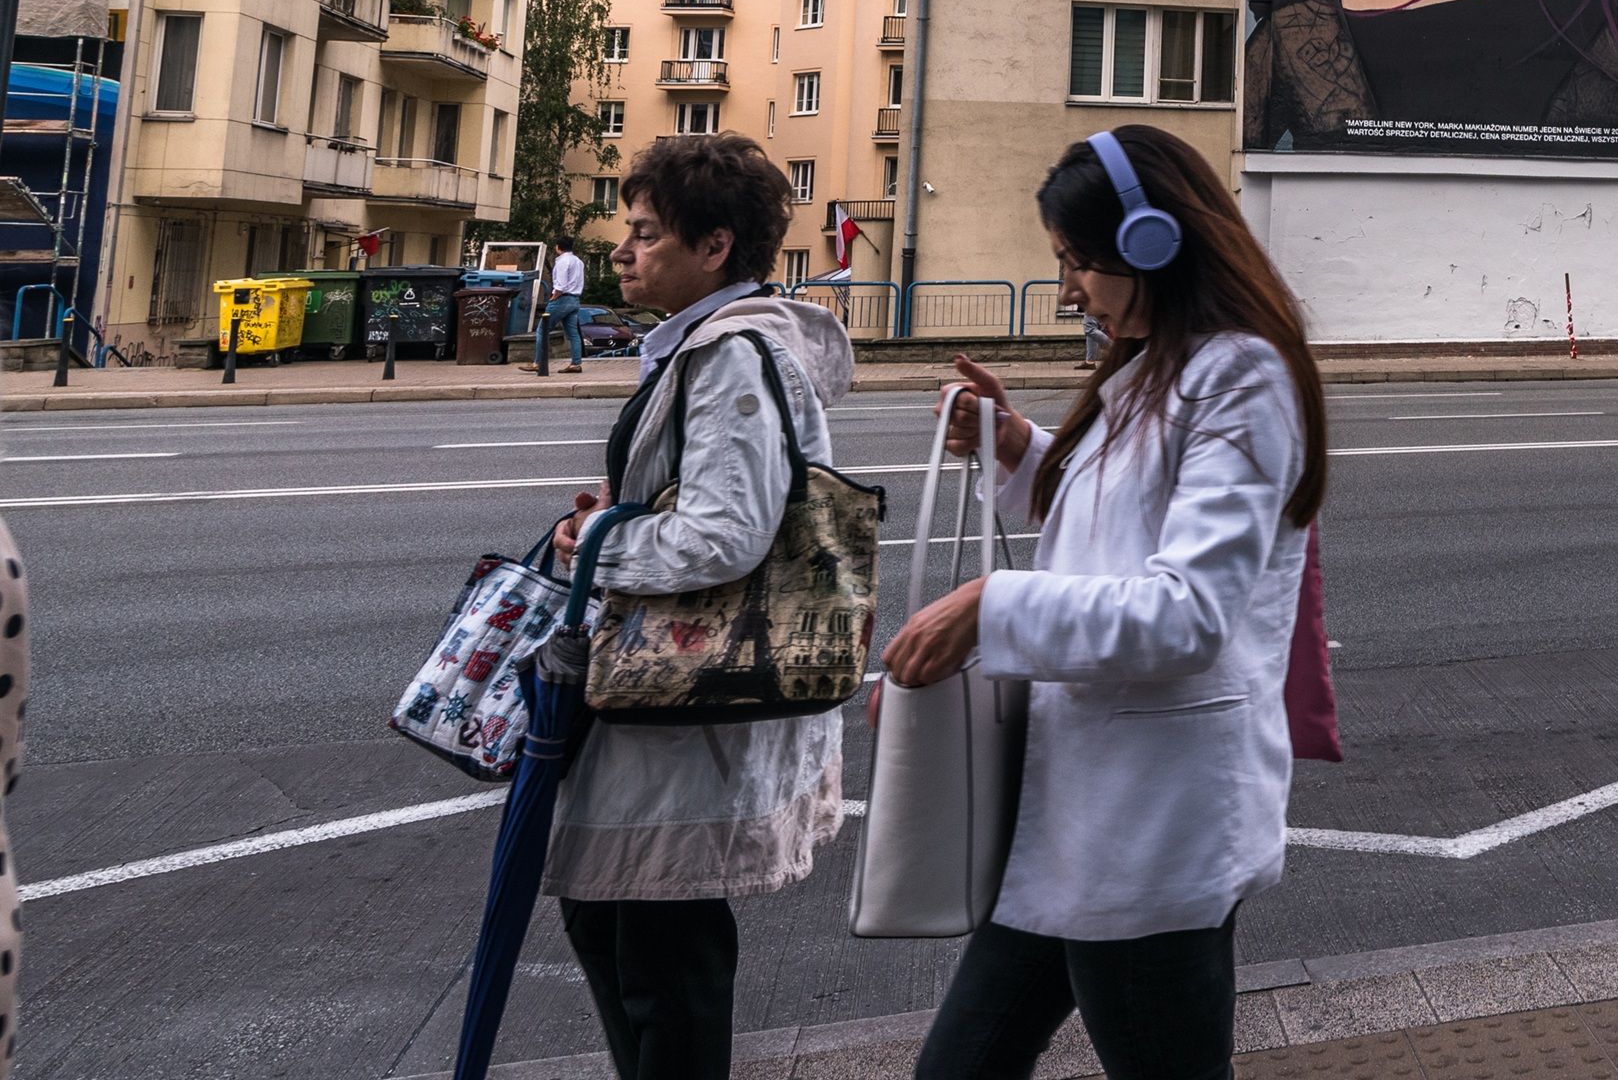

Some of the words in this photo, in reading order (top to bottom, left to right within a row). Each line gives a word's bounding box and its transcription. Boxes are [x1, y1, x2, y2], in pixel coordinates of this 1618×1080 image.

[1347, 128, 1384, 136] WARTOŚĆ
[1386, 129, 1428, 138] SPRZEDAŻY
[1480, 132, 1500, 140] CENA
[1502, 132, 1542, 140] SPRZEDAŻY
[1438, 122, 1463, 130] MARKA
[1465, 123, 1511, 132] MAKIJAŻOWA
[1575, 126, 1602, 134] ŚWIECIE
